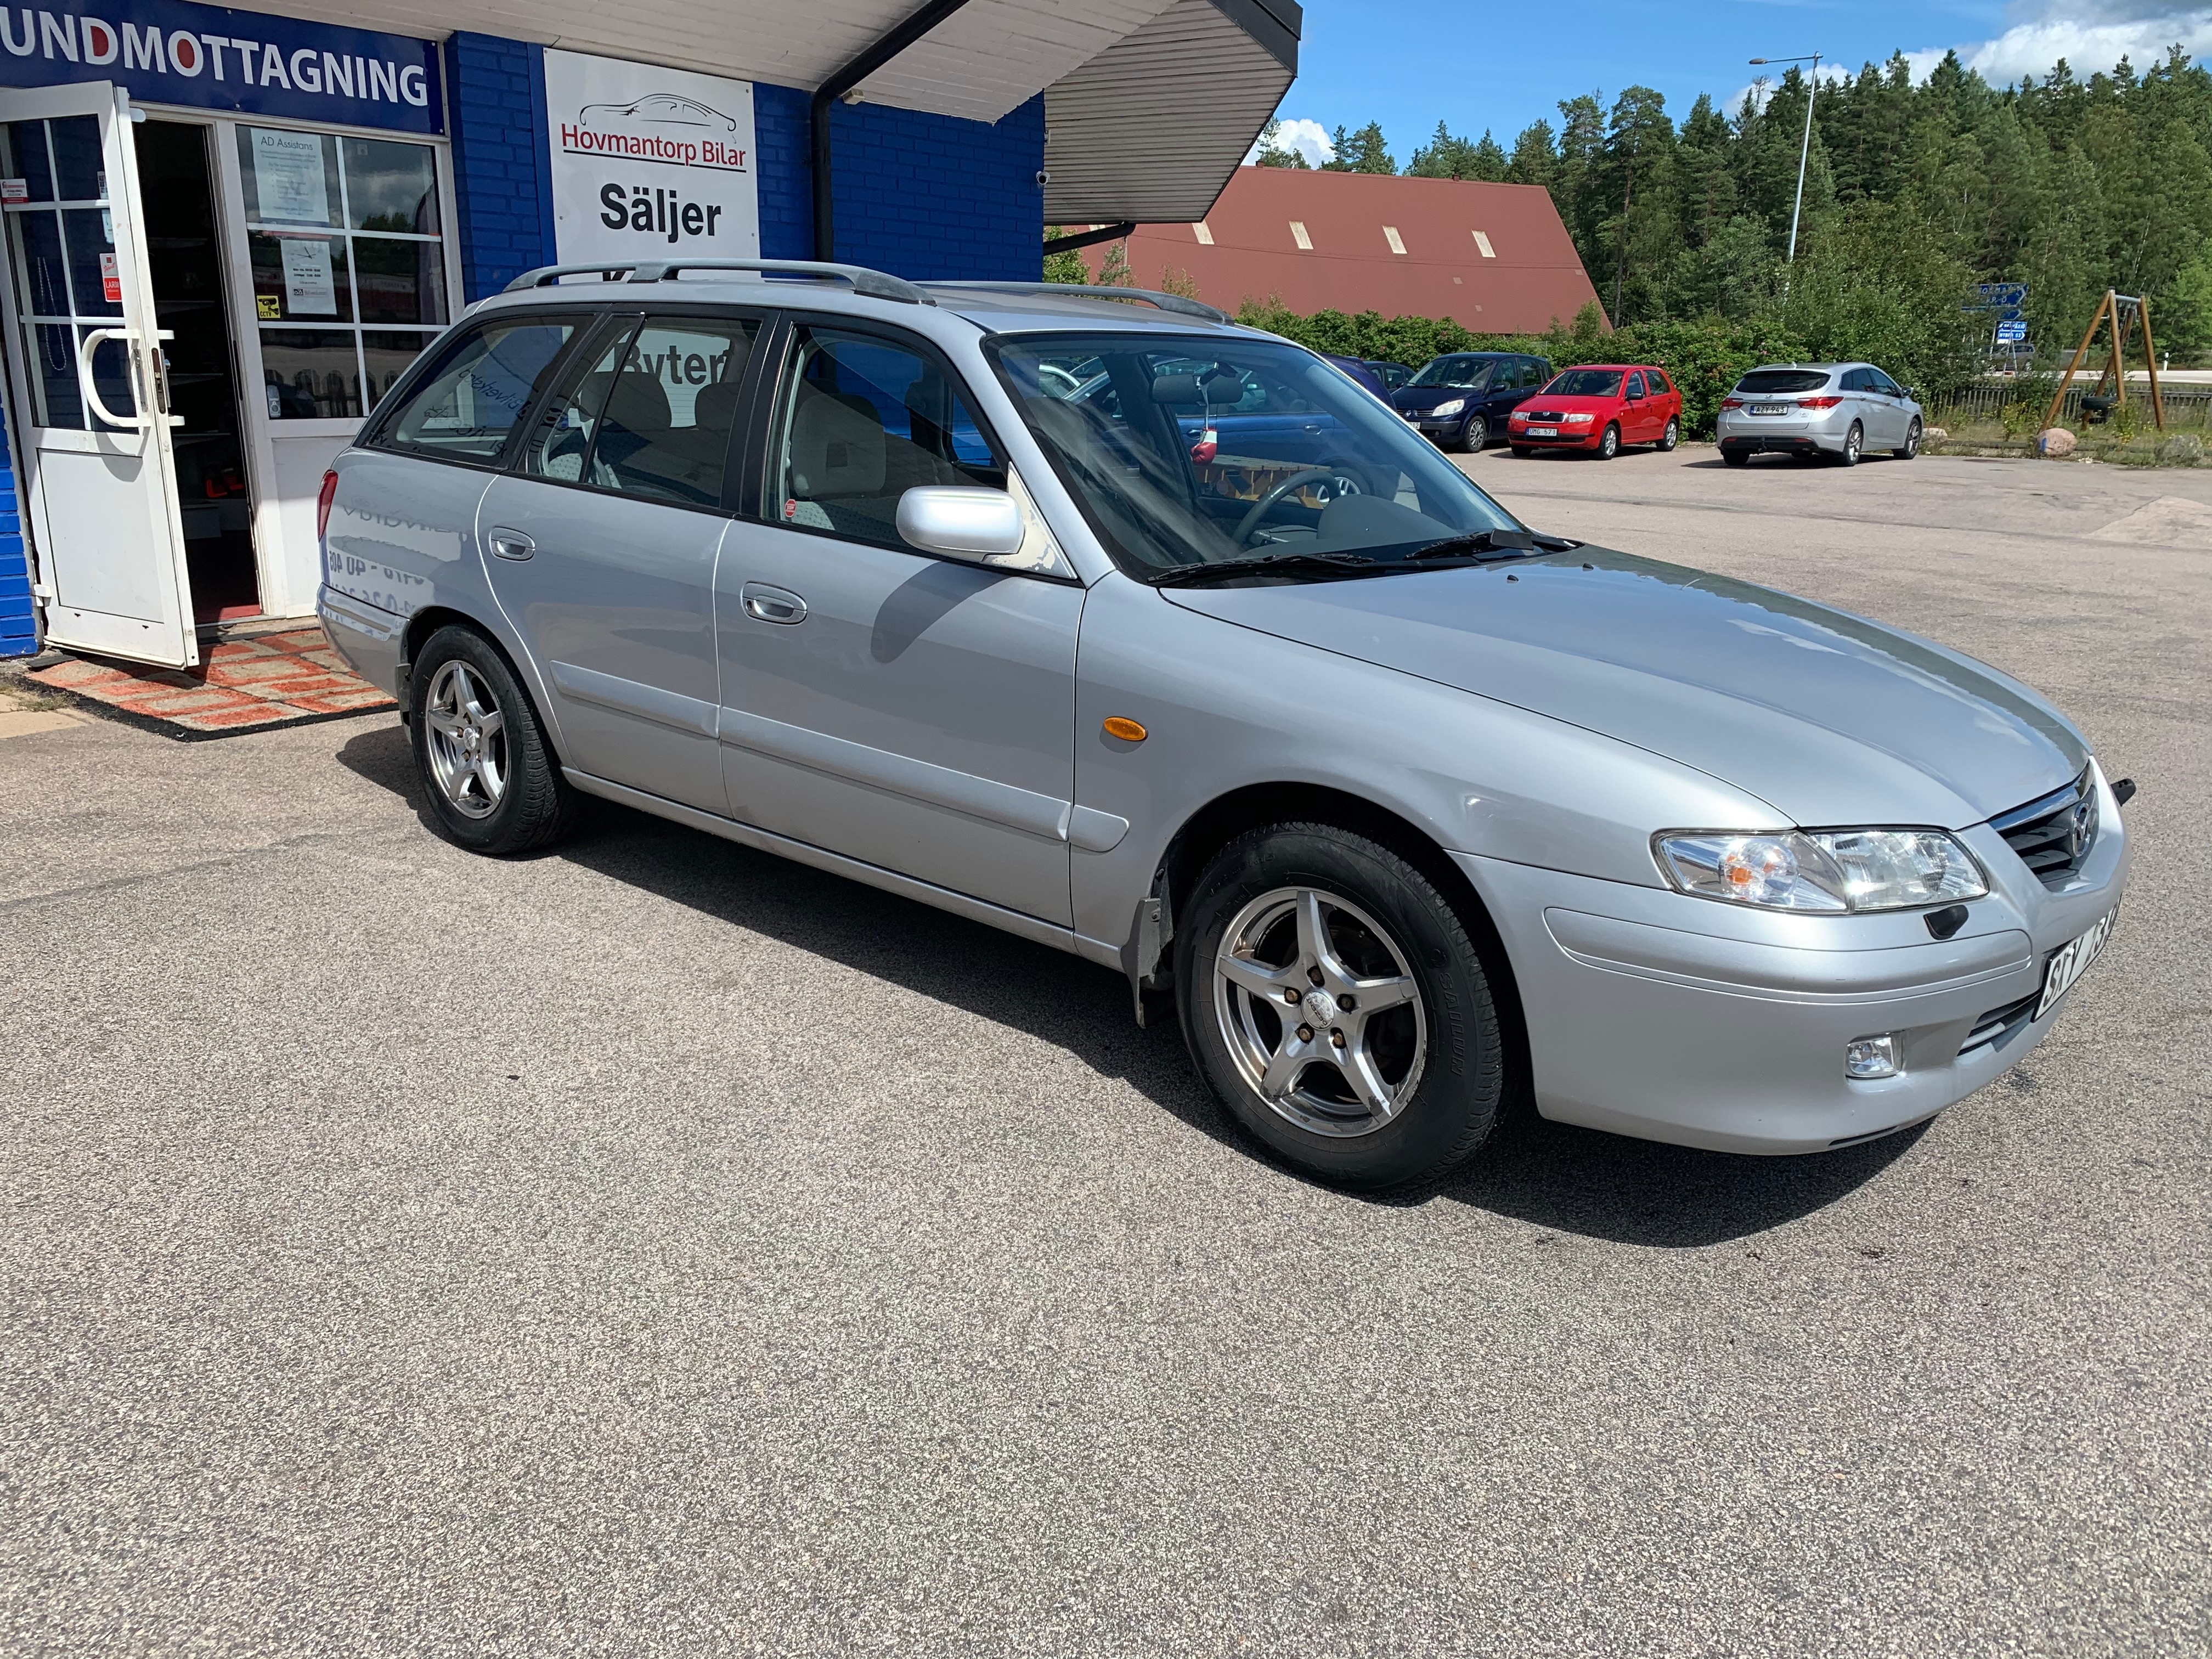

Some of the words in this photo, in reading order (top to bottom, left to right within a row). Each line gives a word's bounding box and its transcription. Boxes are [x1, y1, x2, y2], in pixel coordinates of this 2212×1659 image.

[0, 6, 428, 106] UNDMOTTAGNING
[261, 136, 274, 146] AD
[277, 138, 313, 150] Assistans
[561, 123, 697, 166] Hovmantorp
[702, 140, 746, 166] Bilar
[600, 183, 721, 244] Säljer
[1306, 998, 1328, 1026] DEZENT
[1438, 972, 1465, 1076] SAILUN
